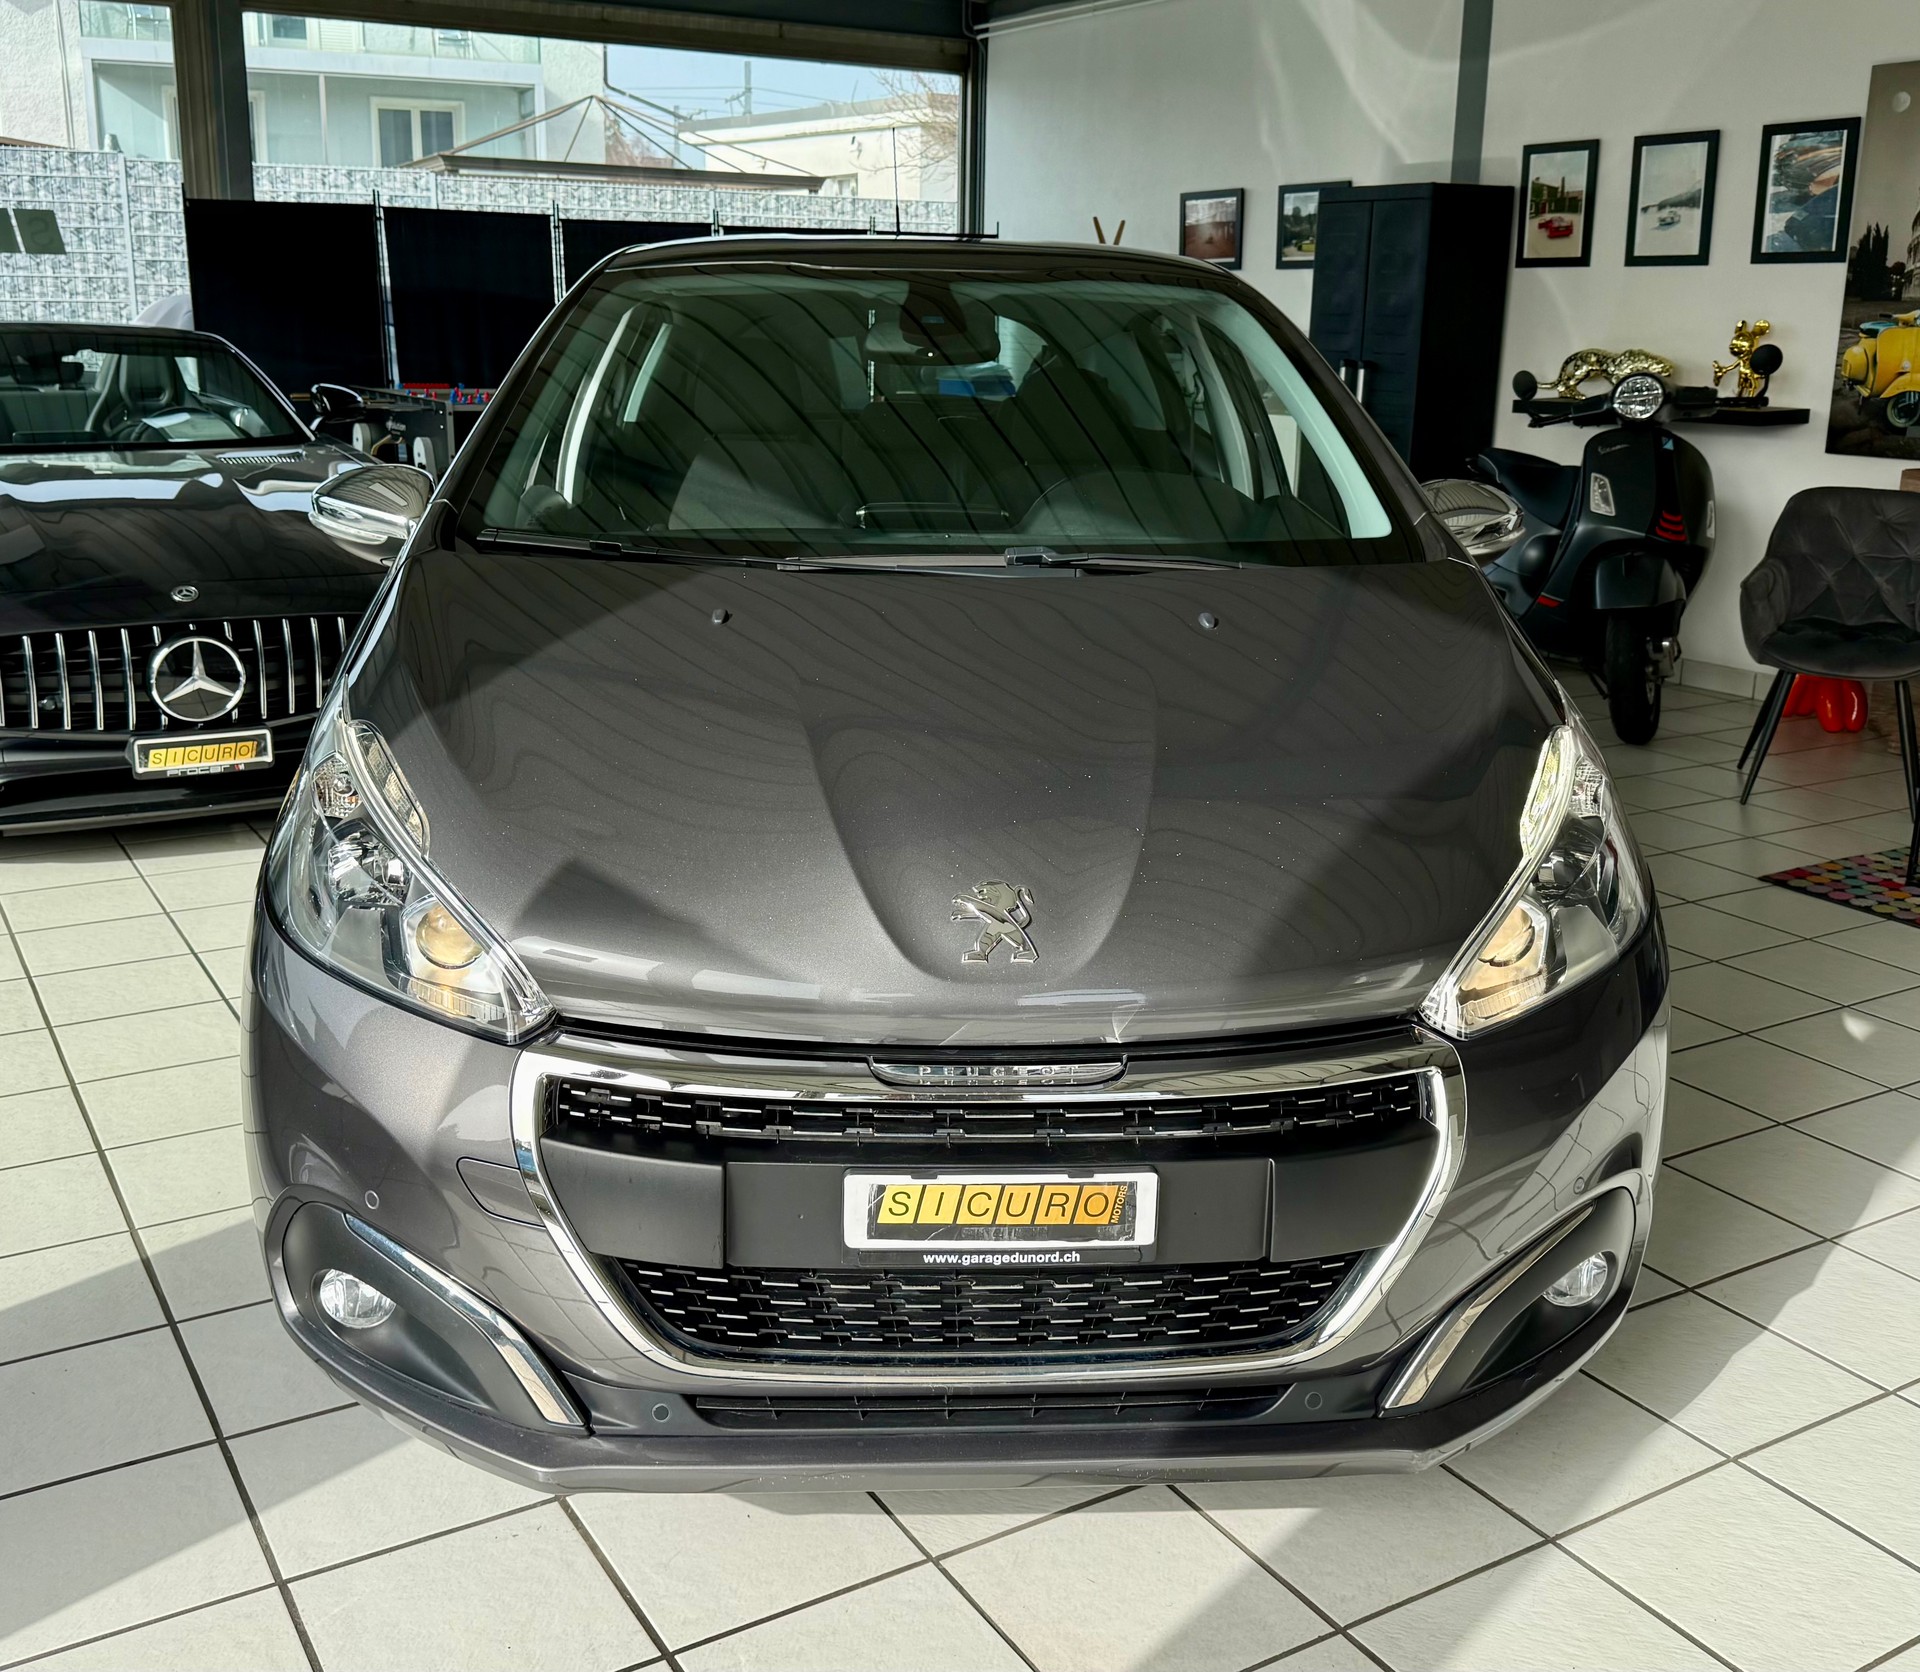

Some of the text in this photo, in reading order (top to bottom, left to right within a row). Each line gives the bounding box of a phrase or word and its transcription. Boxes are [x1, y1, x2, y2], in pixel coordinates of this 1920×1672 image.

[152, 744, 250, 765] SICURO
[918, 1066, 1079, 1077] PEUGEOT
[888, 1190, 1109, 1218] SICURO
[1110, 1185, 1128, 1224] MOTORS
[922, 1251, 1081, 1266] www.garagedunord.ch
